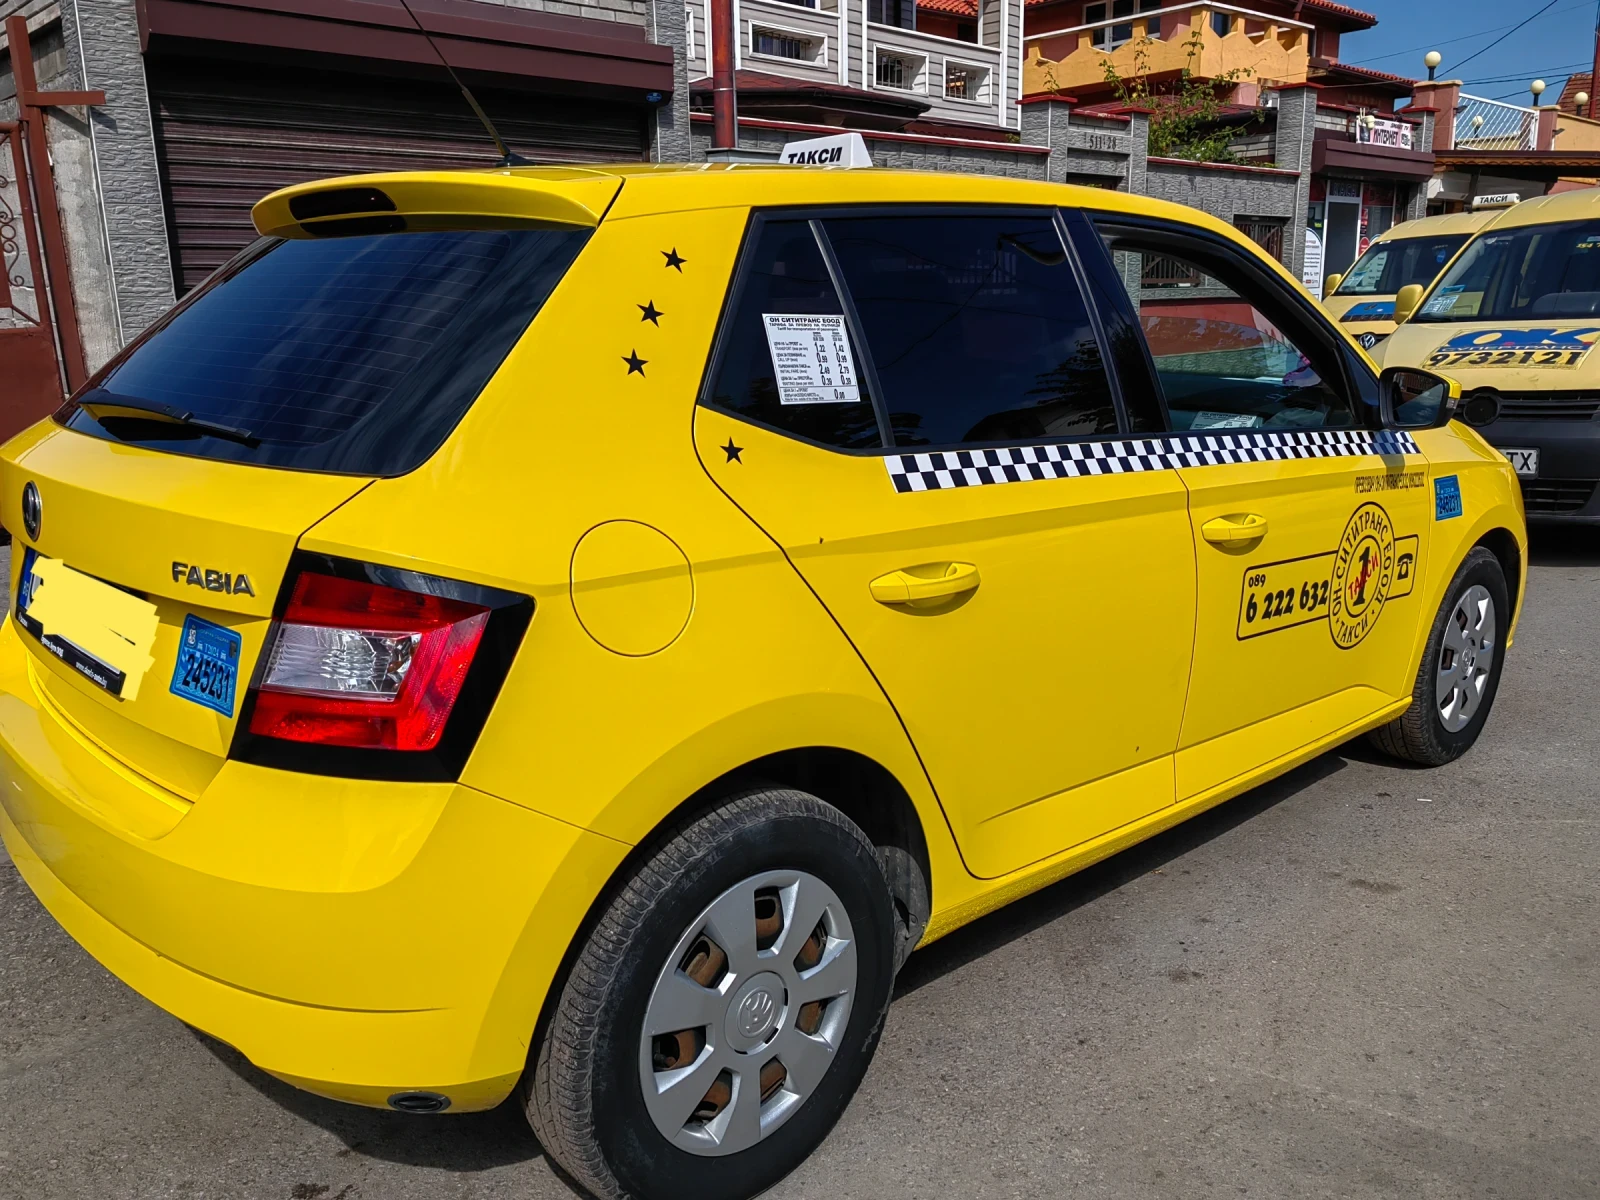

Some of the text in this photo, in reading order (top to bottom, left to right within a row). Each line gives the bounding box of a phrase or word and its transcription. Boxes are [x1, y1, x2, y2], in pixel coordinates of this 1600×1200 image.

[1373, 128, 1398, 146] ИНТЕРНЕТ
[788, 147, 843, 165] ТАКСИ
[1480, 195, 1508, 204] ТАКСИ
[1441, 344, 1584, 352] СУПЕРТРАНС
[1429, 351, 1583, 367] 9732121
[1506, 452, 1533, 471] TX
[172, 561, 255, 598] FABIA
[1248, 574, 1266, 588] 089
[1348, 551, 1379, 600] ТАКСИ
[1375, 541, 1392, 605] ЕООД
[1246, 580, 1329, 623] 6 222 632
[1336, 613, 1369, 644] ТАКСИ
[182, 653, 231, 703] 245231
